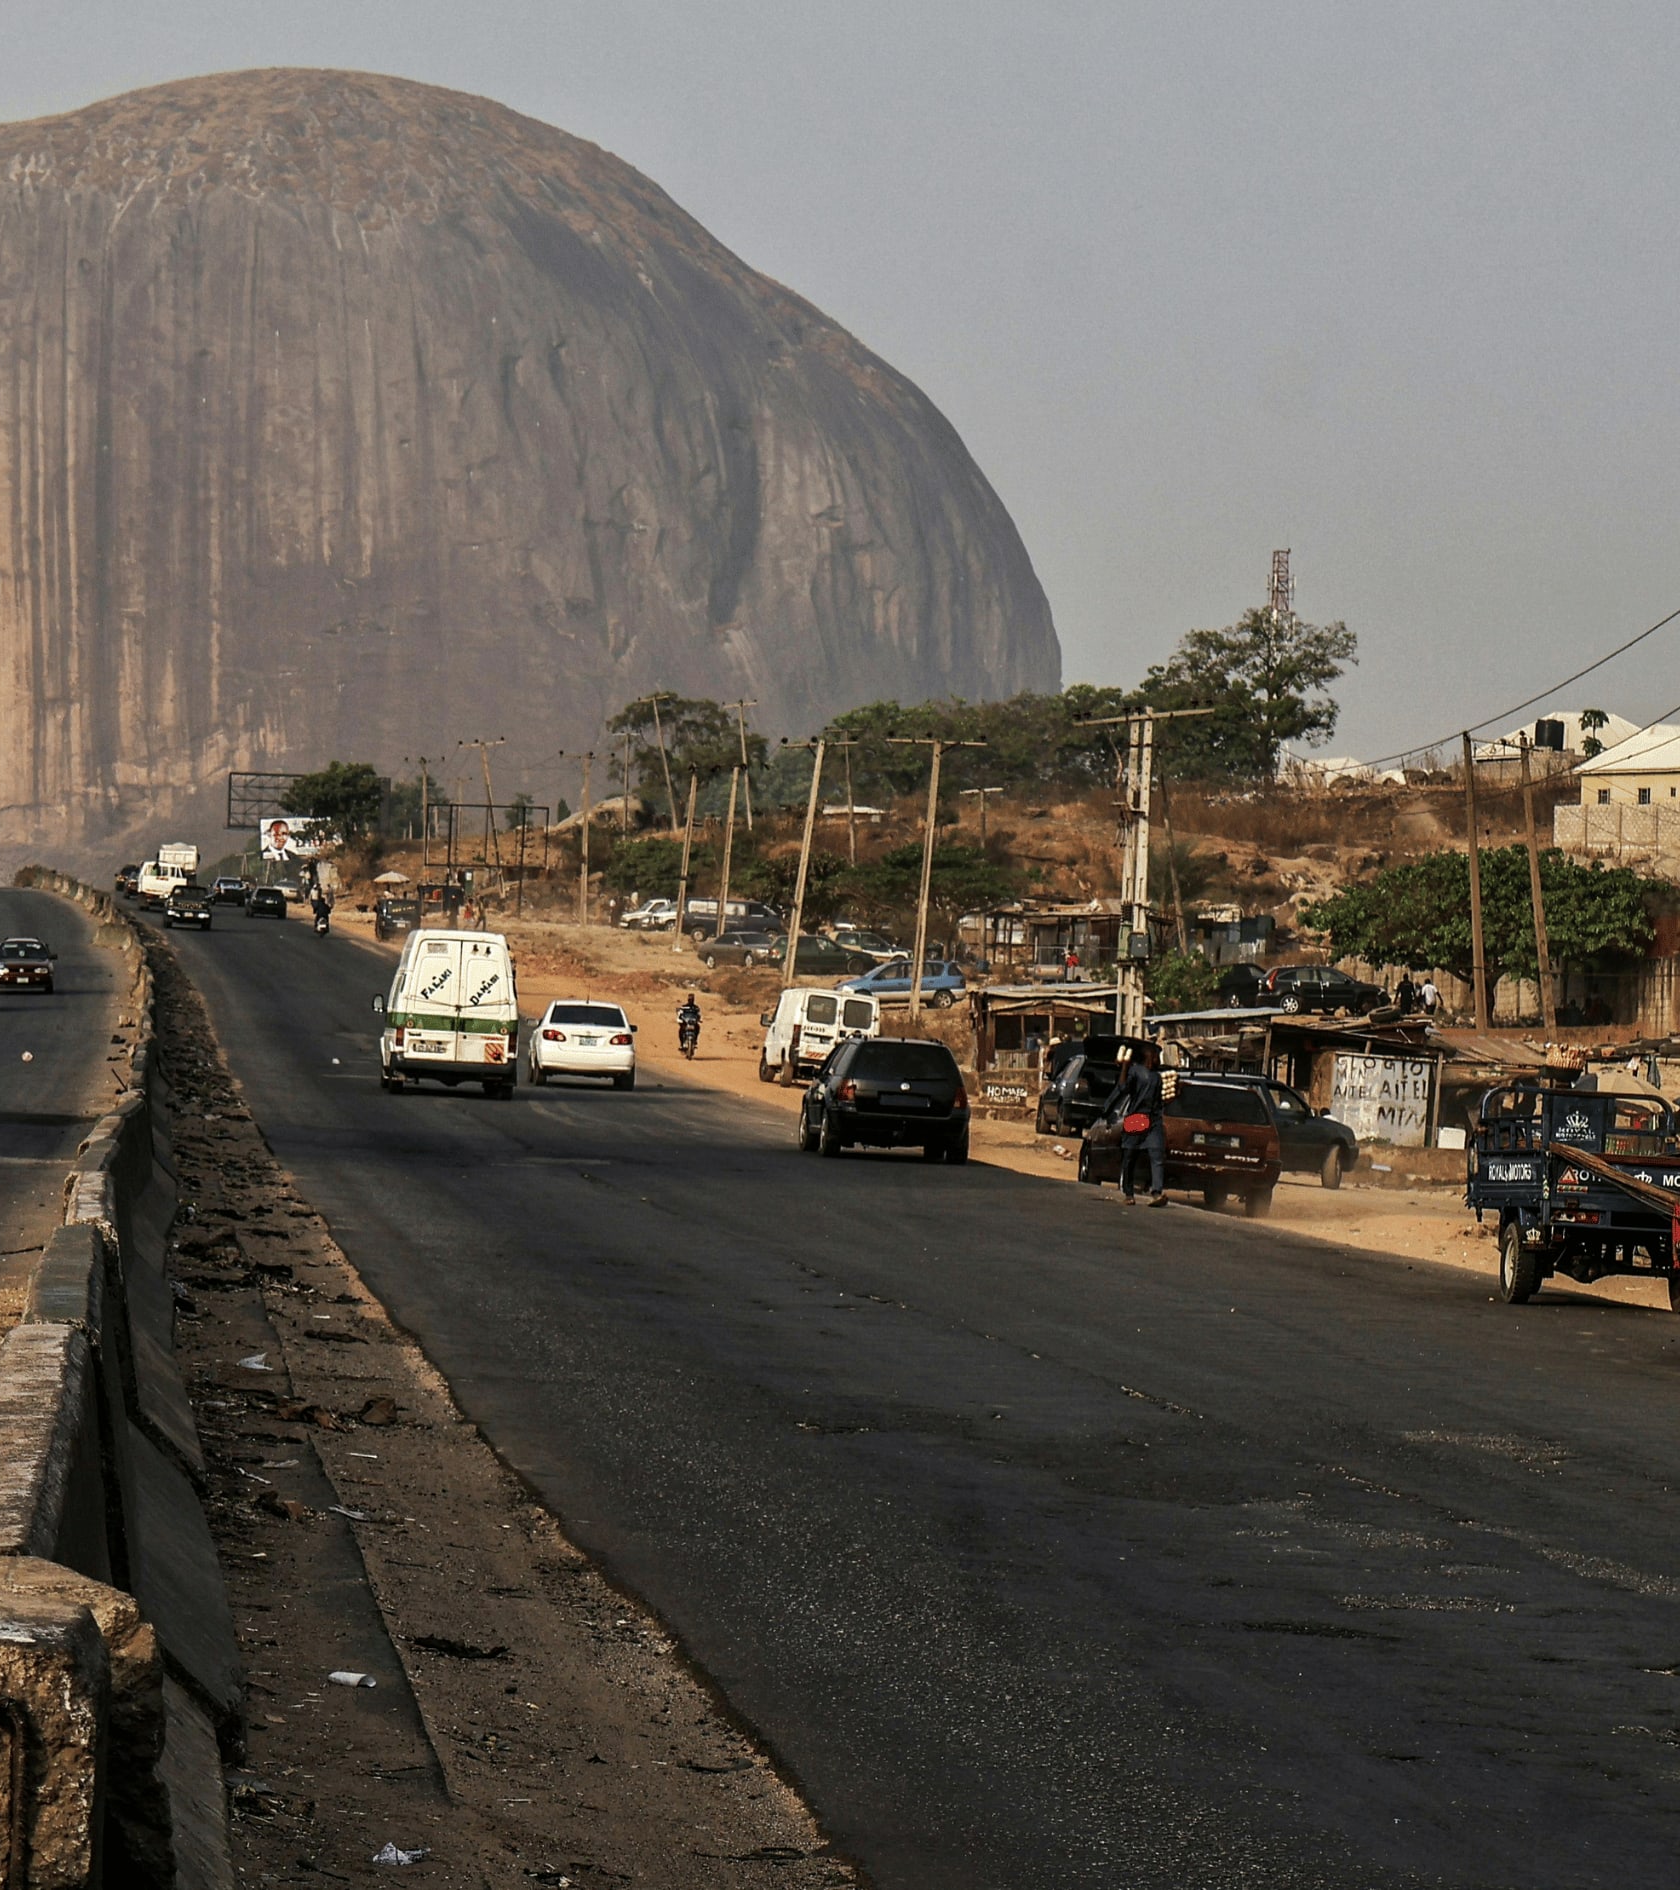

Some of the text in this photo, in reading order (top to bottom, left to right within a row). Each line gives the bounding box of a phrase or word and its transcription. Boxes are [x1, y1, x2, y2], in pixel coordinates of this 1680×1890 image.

[421, 968, 453, 999] FALAKI
[1384, 1059, 1424, 1079] GLO
[1377, 1106, 1426, 1129] MTN
